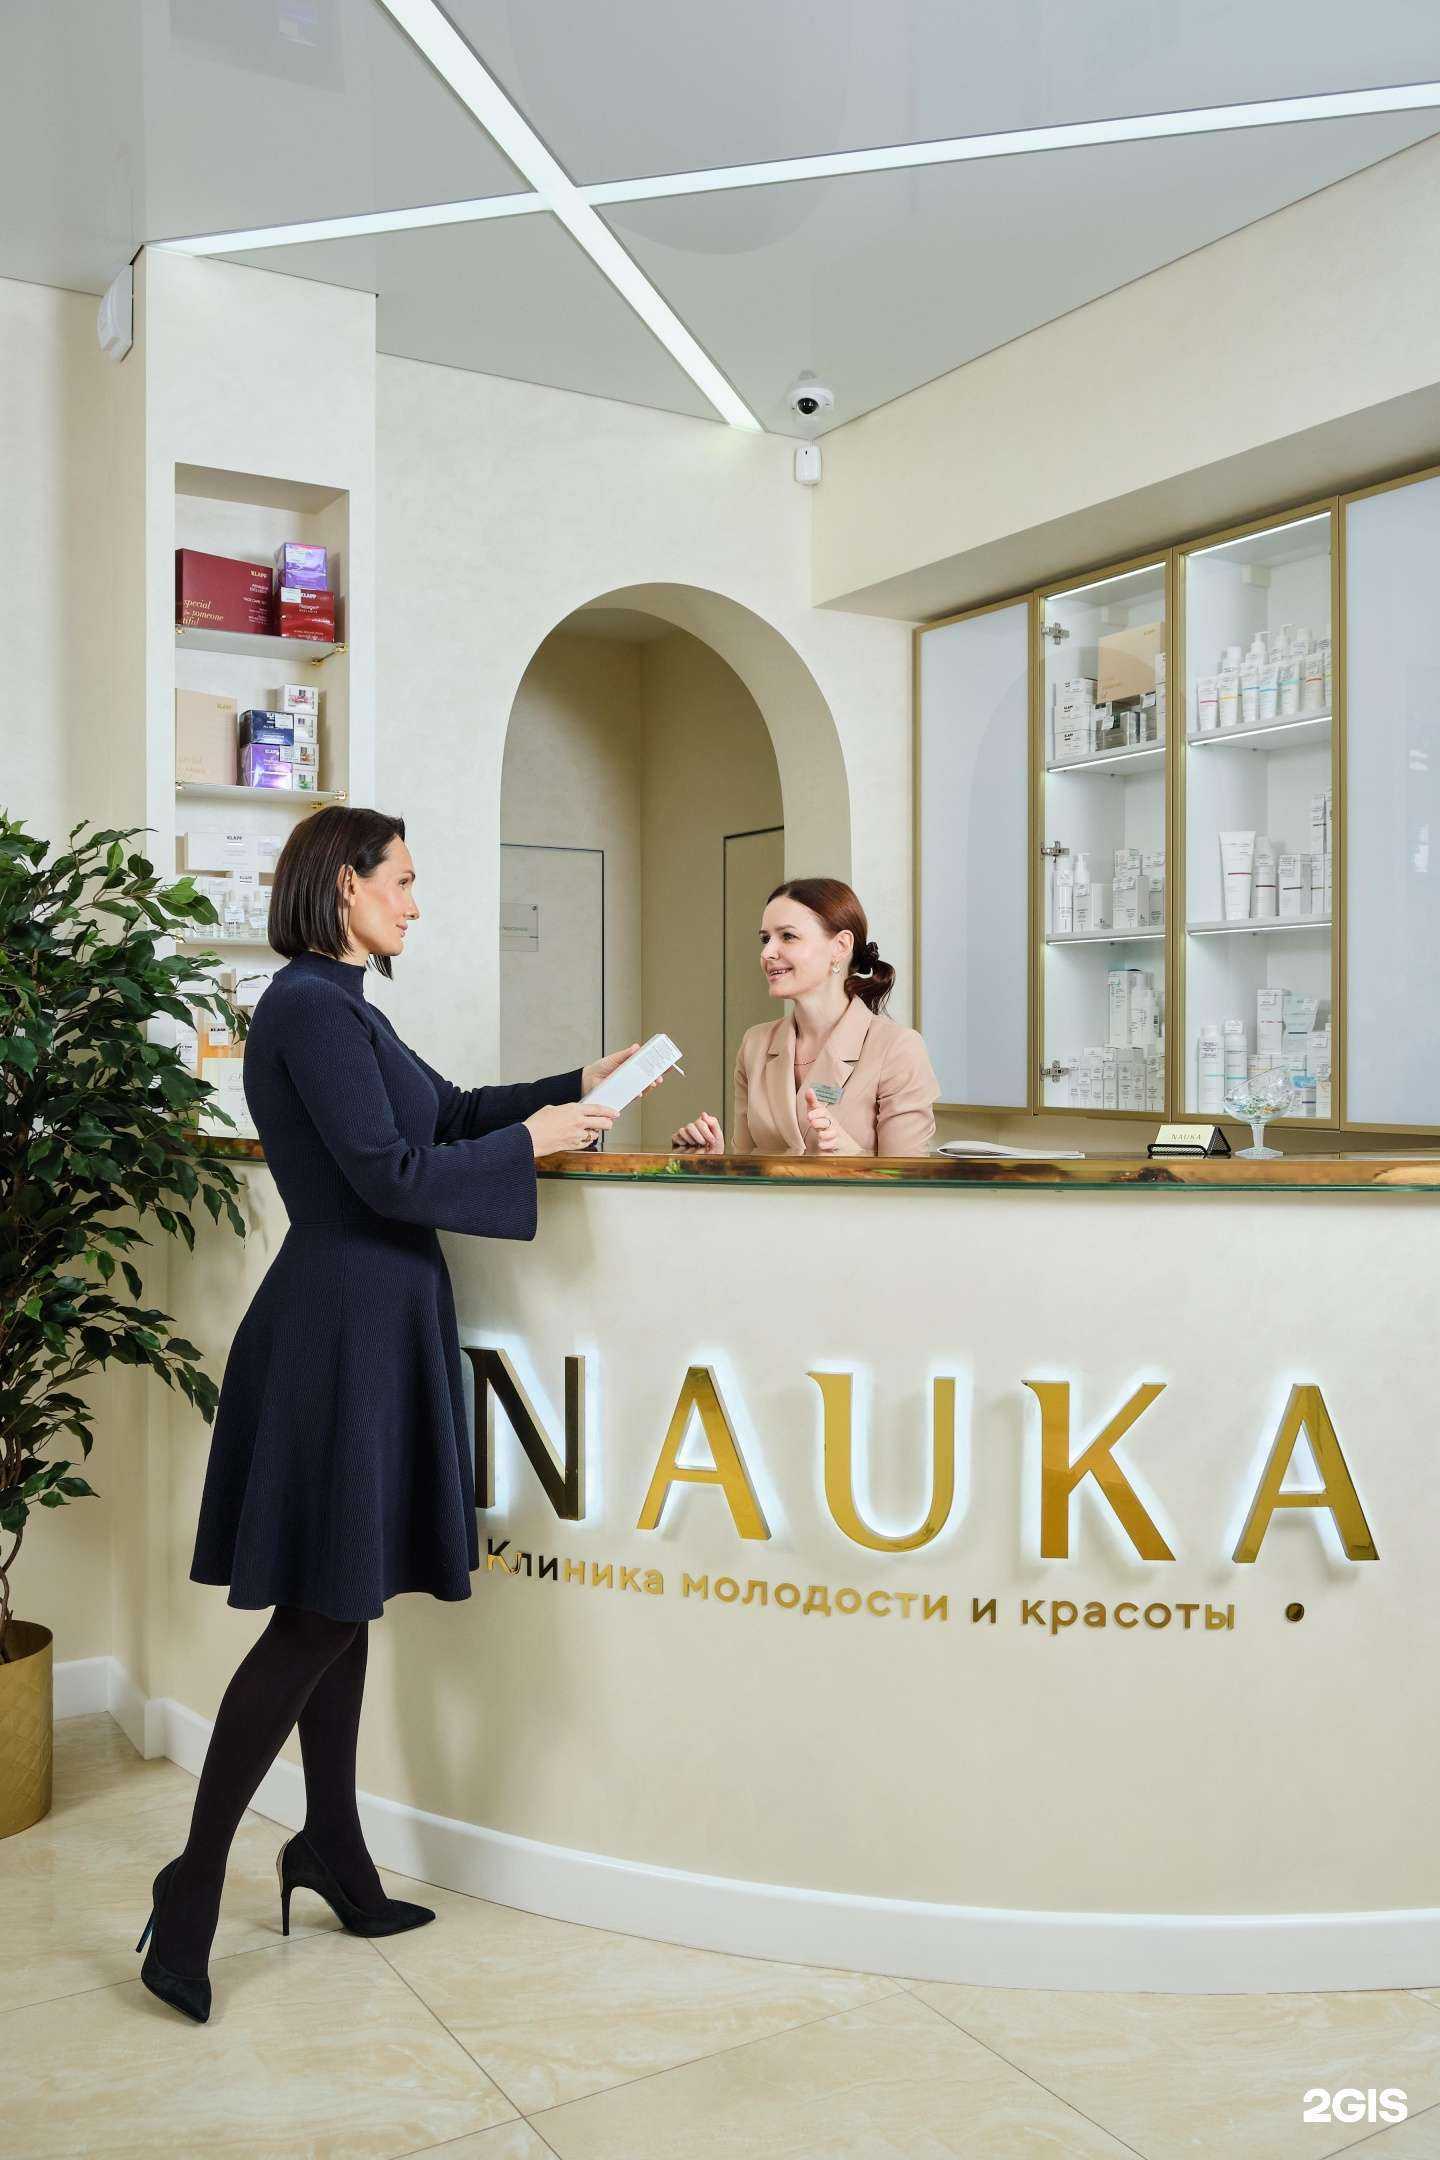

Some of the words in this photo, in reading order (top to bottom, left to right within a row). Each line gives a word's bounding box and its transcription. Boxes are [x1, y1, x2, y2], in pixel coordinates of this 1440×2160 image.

[460, 1346, 1380, 1563] NAUKA
[486, 1536, 664, 1595] Клиника
[682, 1572, 948, 1620] молодости
[972, 1597, 998, 1624] и
[1020, 1599, 1235, 1634] красоты
